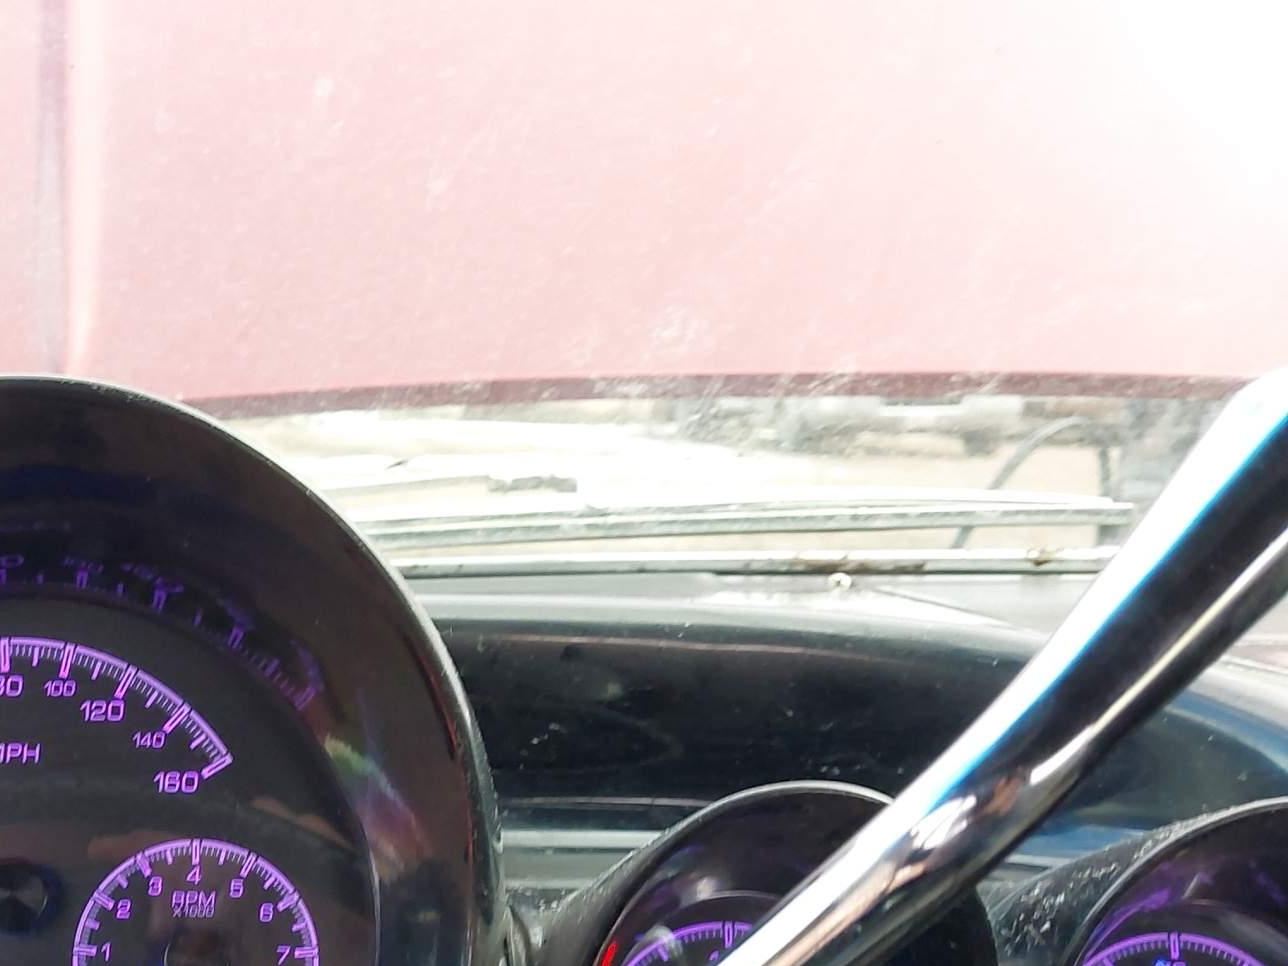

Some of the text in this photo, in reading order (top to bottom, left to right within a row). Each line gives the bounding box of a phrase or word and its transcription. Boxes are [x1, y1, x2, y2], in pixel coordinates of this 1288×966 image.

[44, 680, 76, 697] 100
[80, 700, 125, 721] 120
[133, 732, 166, 750] 140
[153, 771, 199, 793] 160
[187, 866, 201, 885] 4
[148, 876, 163, 897] 3
[172, 891, 216, 906] RPM
[116, 899, 131, 919] 2
[101, 943, 111, 962] 1
[276, 945, 291, 965] 7
